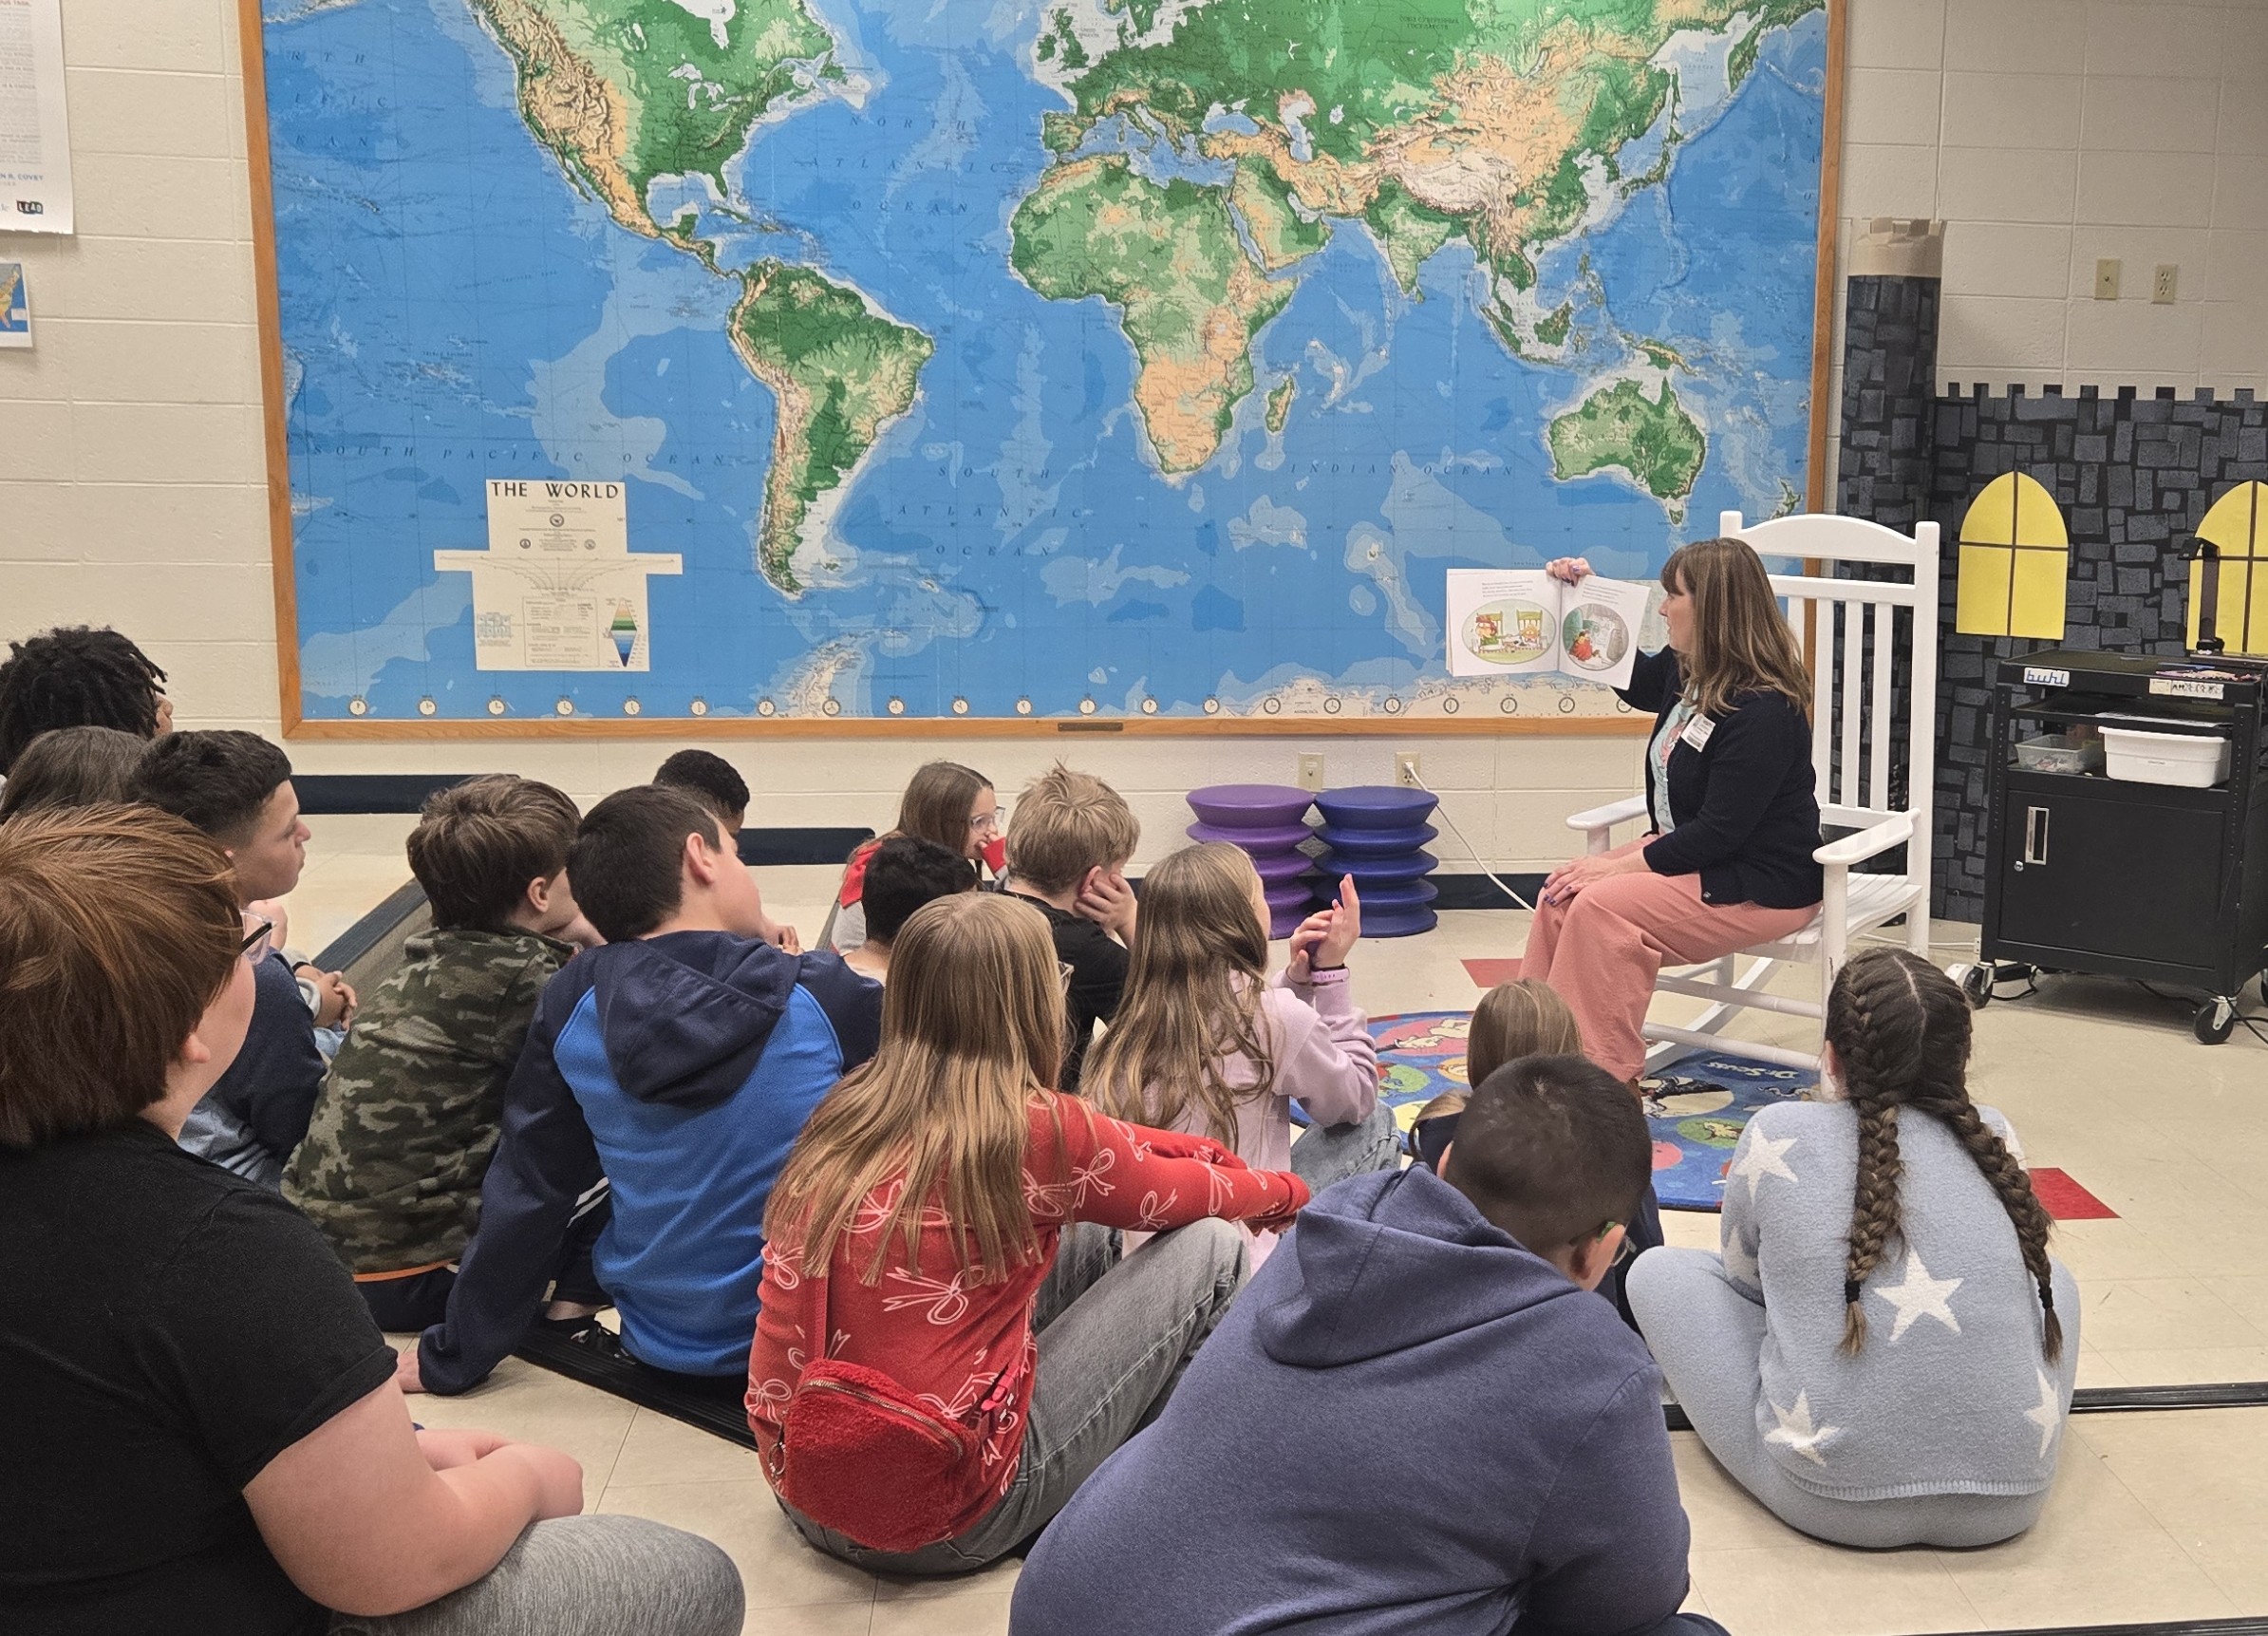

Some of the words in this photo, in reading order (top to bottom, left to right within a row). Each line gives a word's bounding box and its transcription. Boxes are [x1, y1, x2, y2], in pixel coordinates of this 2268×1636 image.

[850, 117, 966, 130] NORTH
[812, 158, 998, 173] ATLANTIC
[17, 200, 43, 215] LEAD
[853, 199, 967, 213] OCEAN
[314, 446, 414, 458] SOUTH
[442, 449, 583, 461] PACIFIC
[622, 453, 723, 464] OCEAN
[938, 466, 1050, 479] SOUTH
[1290, 463, 1397, 475] INDIAN
[1424, 464, 1512, 476] OCEAN
[491, 481, 528, 498] THE
[545, 482, 618, 499] WORLD
[898, 505, 1081, 518] ATLANTIC
[936, 545, 1050, 556] OCEAN
[2026, 669, 2067, 685] buhl
